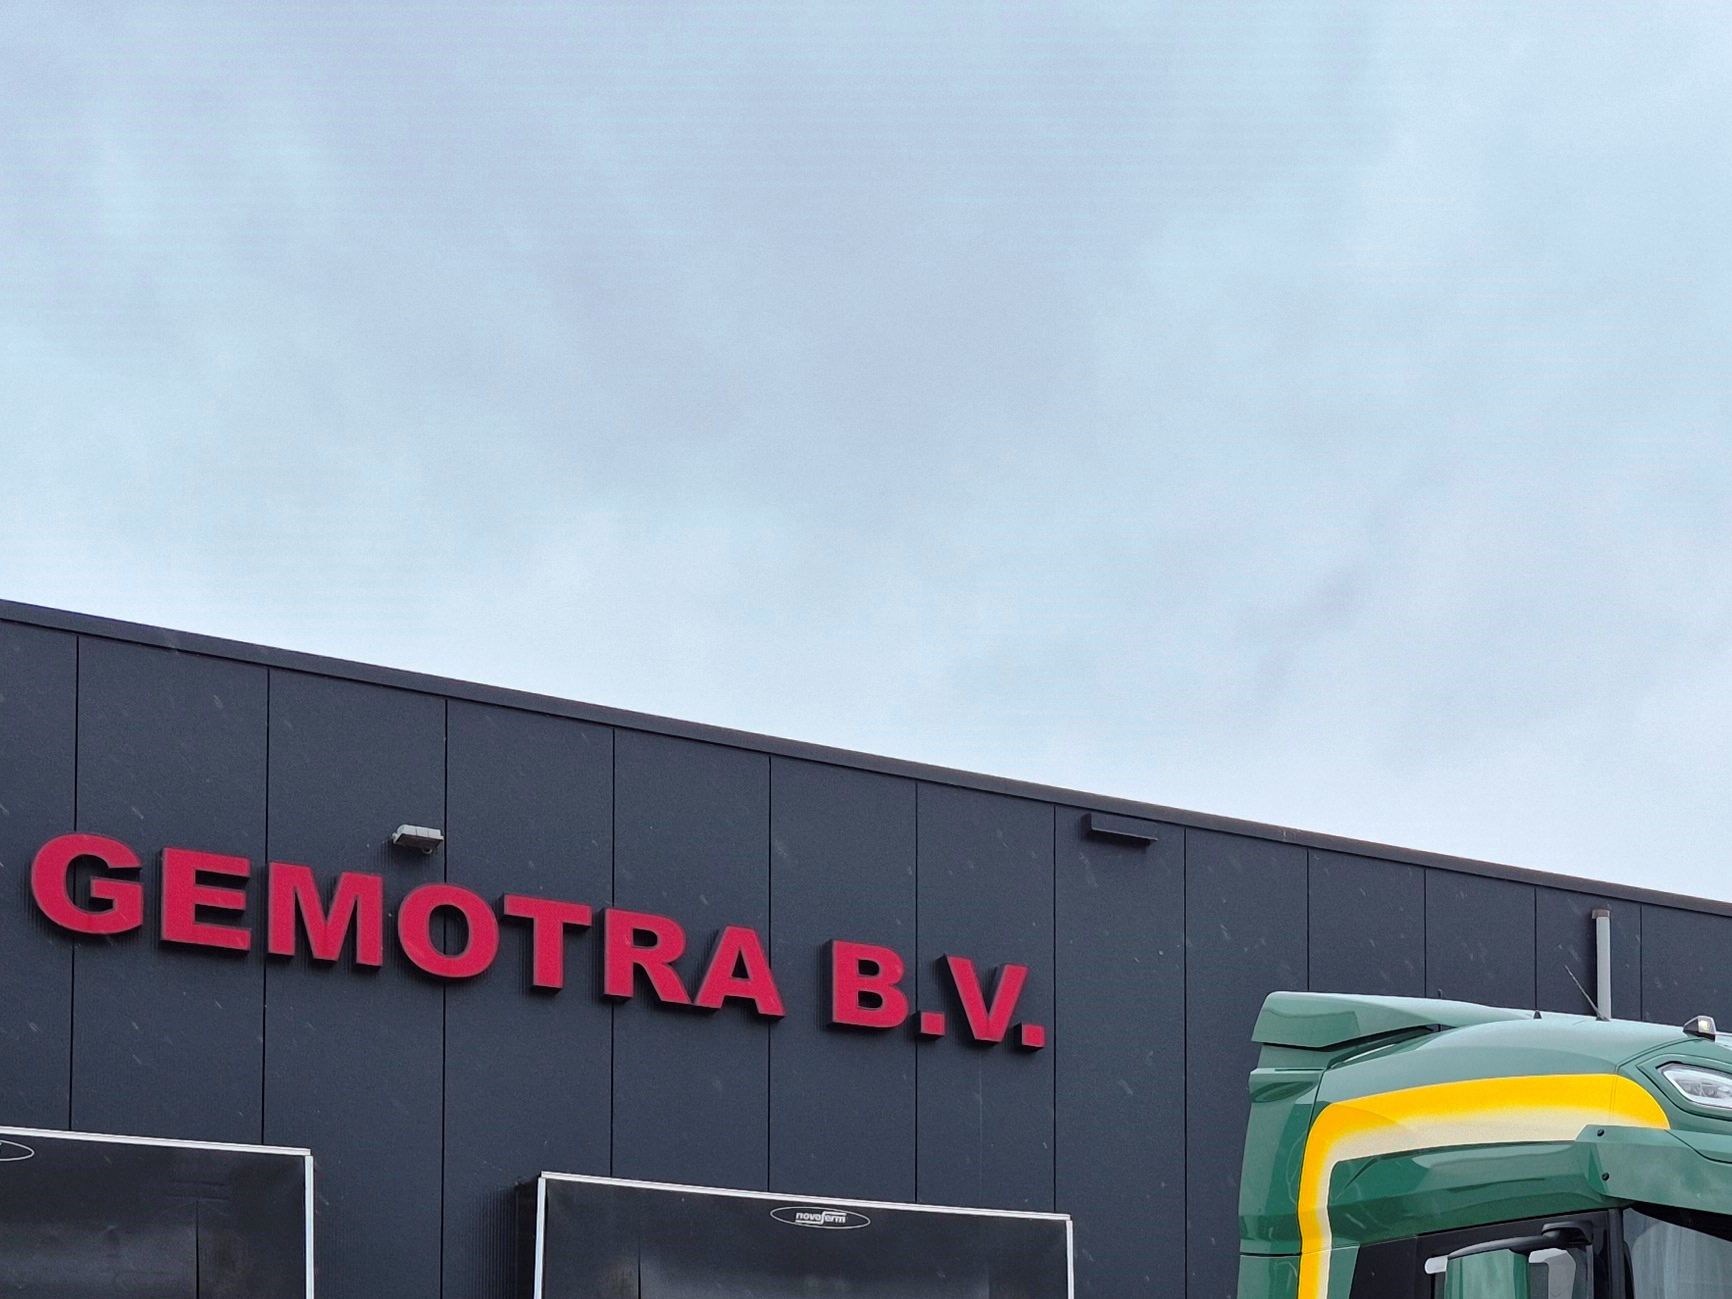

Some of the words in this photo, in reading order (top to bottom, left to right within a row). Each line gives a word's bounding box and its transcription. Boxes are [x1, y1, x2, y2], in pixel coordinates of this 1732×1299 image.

[31, 833, 786, 1018] GEMOTRA
[829, 938, 1046, 1049] B.V.
[795, 1211, 847, 1225] novoferm
